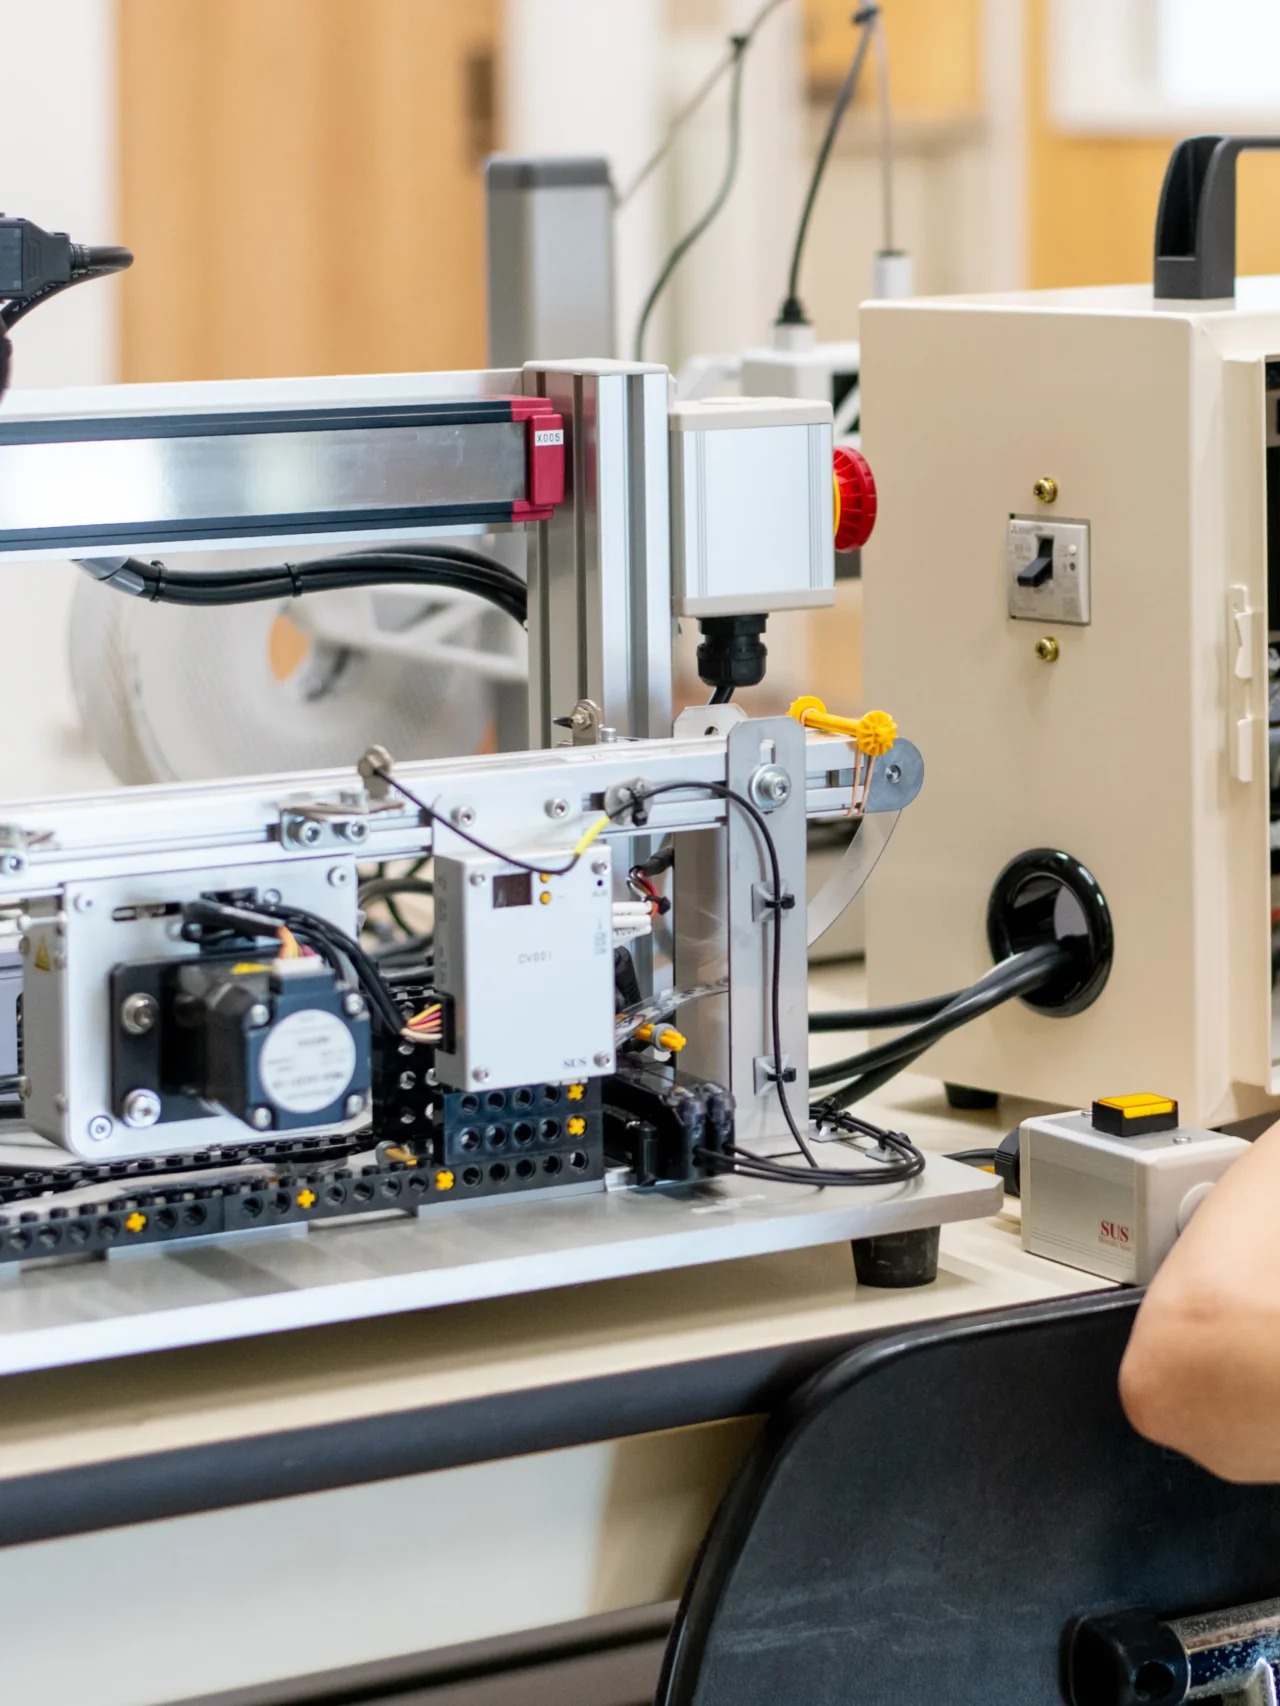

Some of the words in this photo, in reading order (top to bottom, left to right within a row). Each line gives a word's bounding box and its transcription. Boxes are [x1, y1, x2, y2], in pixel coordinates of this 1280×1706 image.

[537, 433, 561, 443] X005
[562, 1057, 588, 1071] SUS
[1101, 1220, 1129, 1243] SUS
